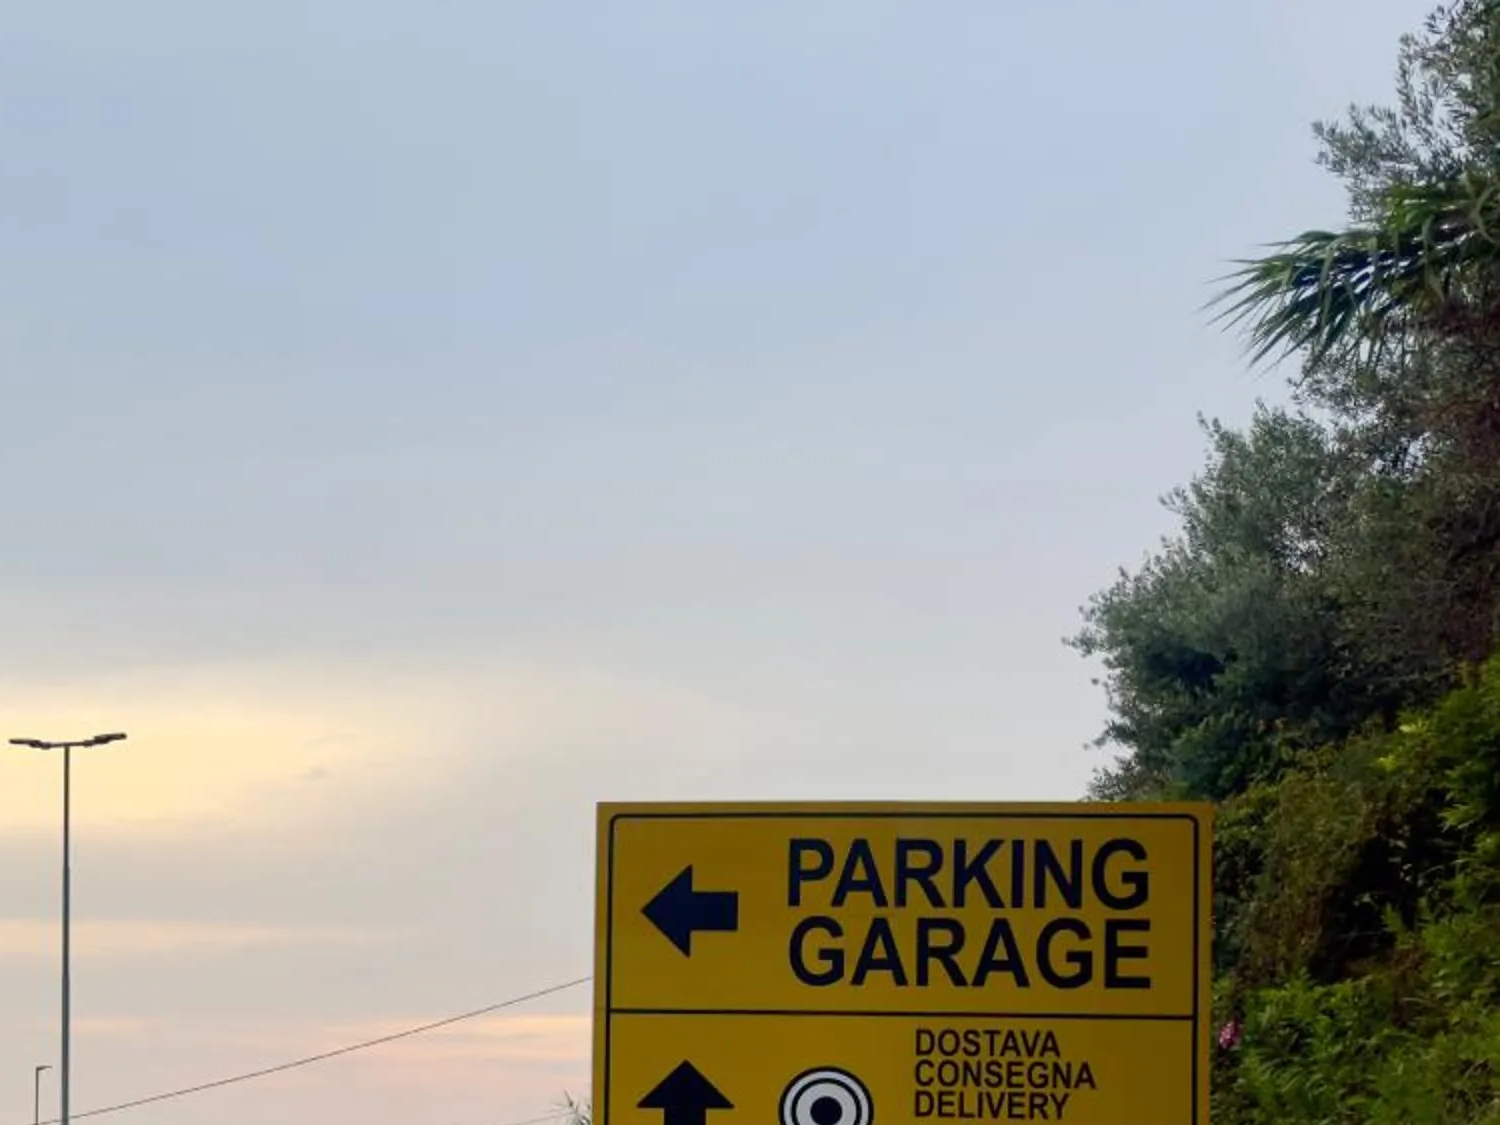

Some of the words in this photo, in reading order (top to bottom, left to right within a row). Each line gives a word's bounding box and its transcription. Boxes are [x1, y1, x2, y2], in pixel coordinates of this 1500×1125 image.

[787, 837, 1150, 910] PARKING
[788, 916, 1152, 989] GARAGE
[914, 1028, 1061, 1059] DOSTAVA
[913, 1059, 1096, 1091] CONSEGNA
[913, 1091, 1070, 1121] DELIVERY
